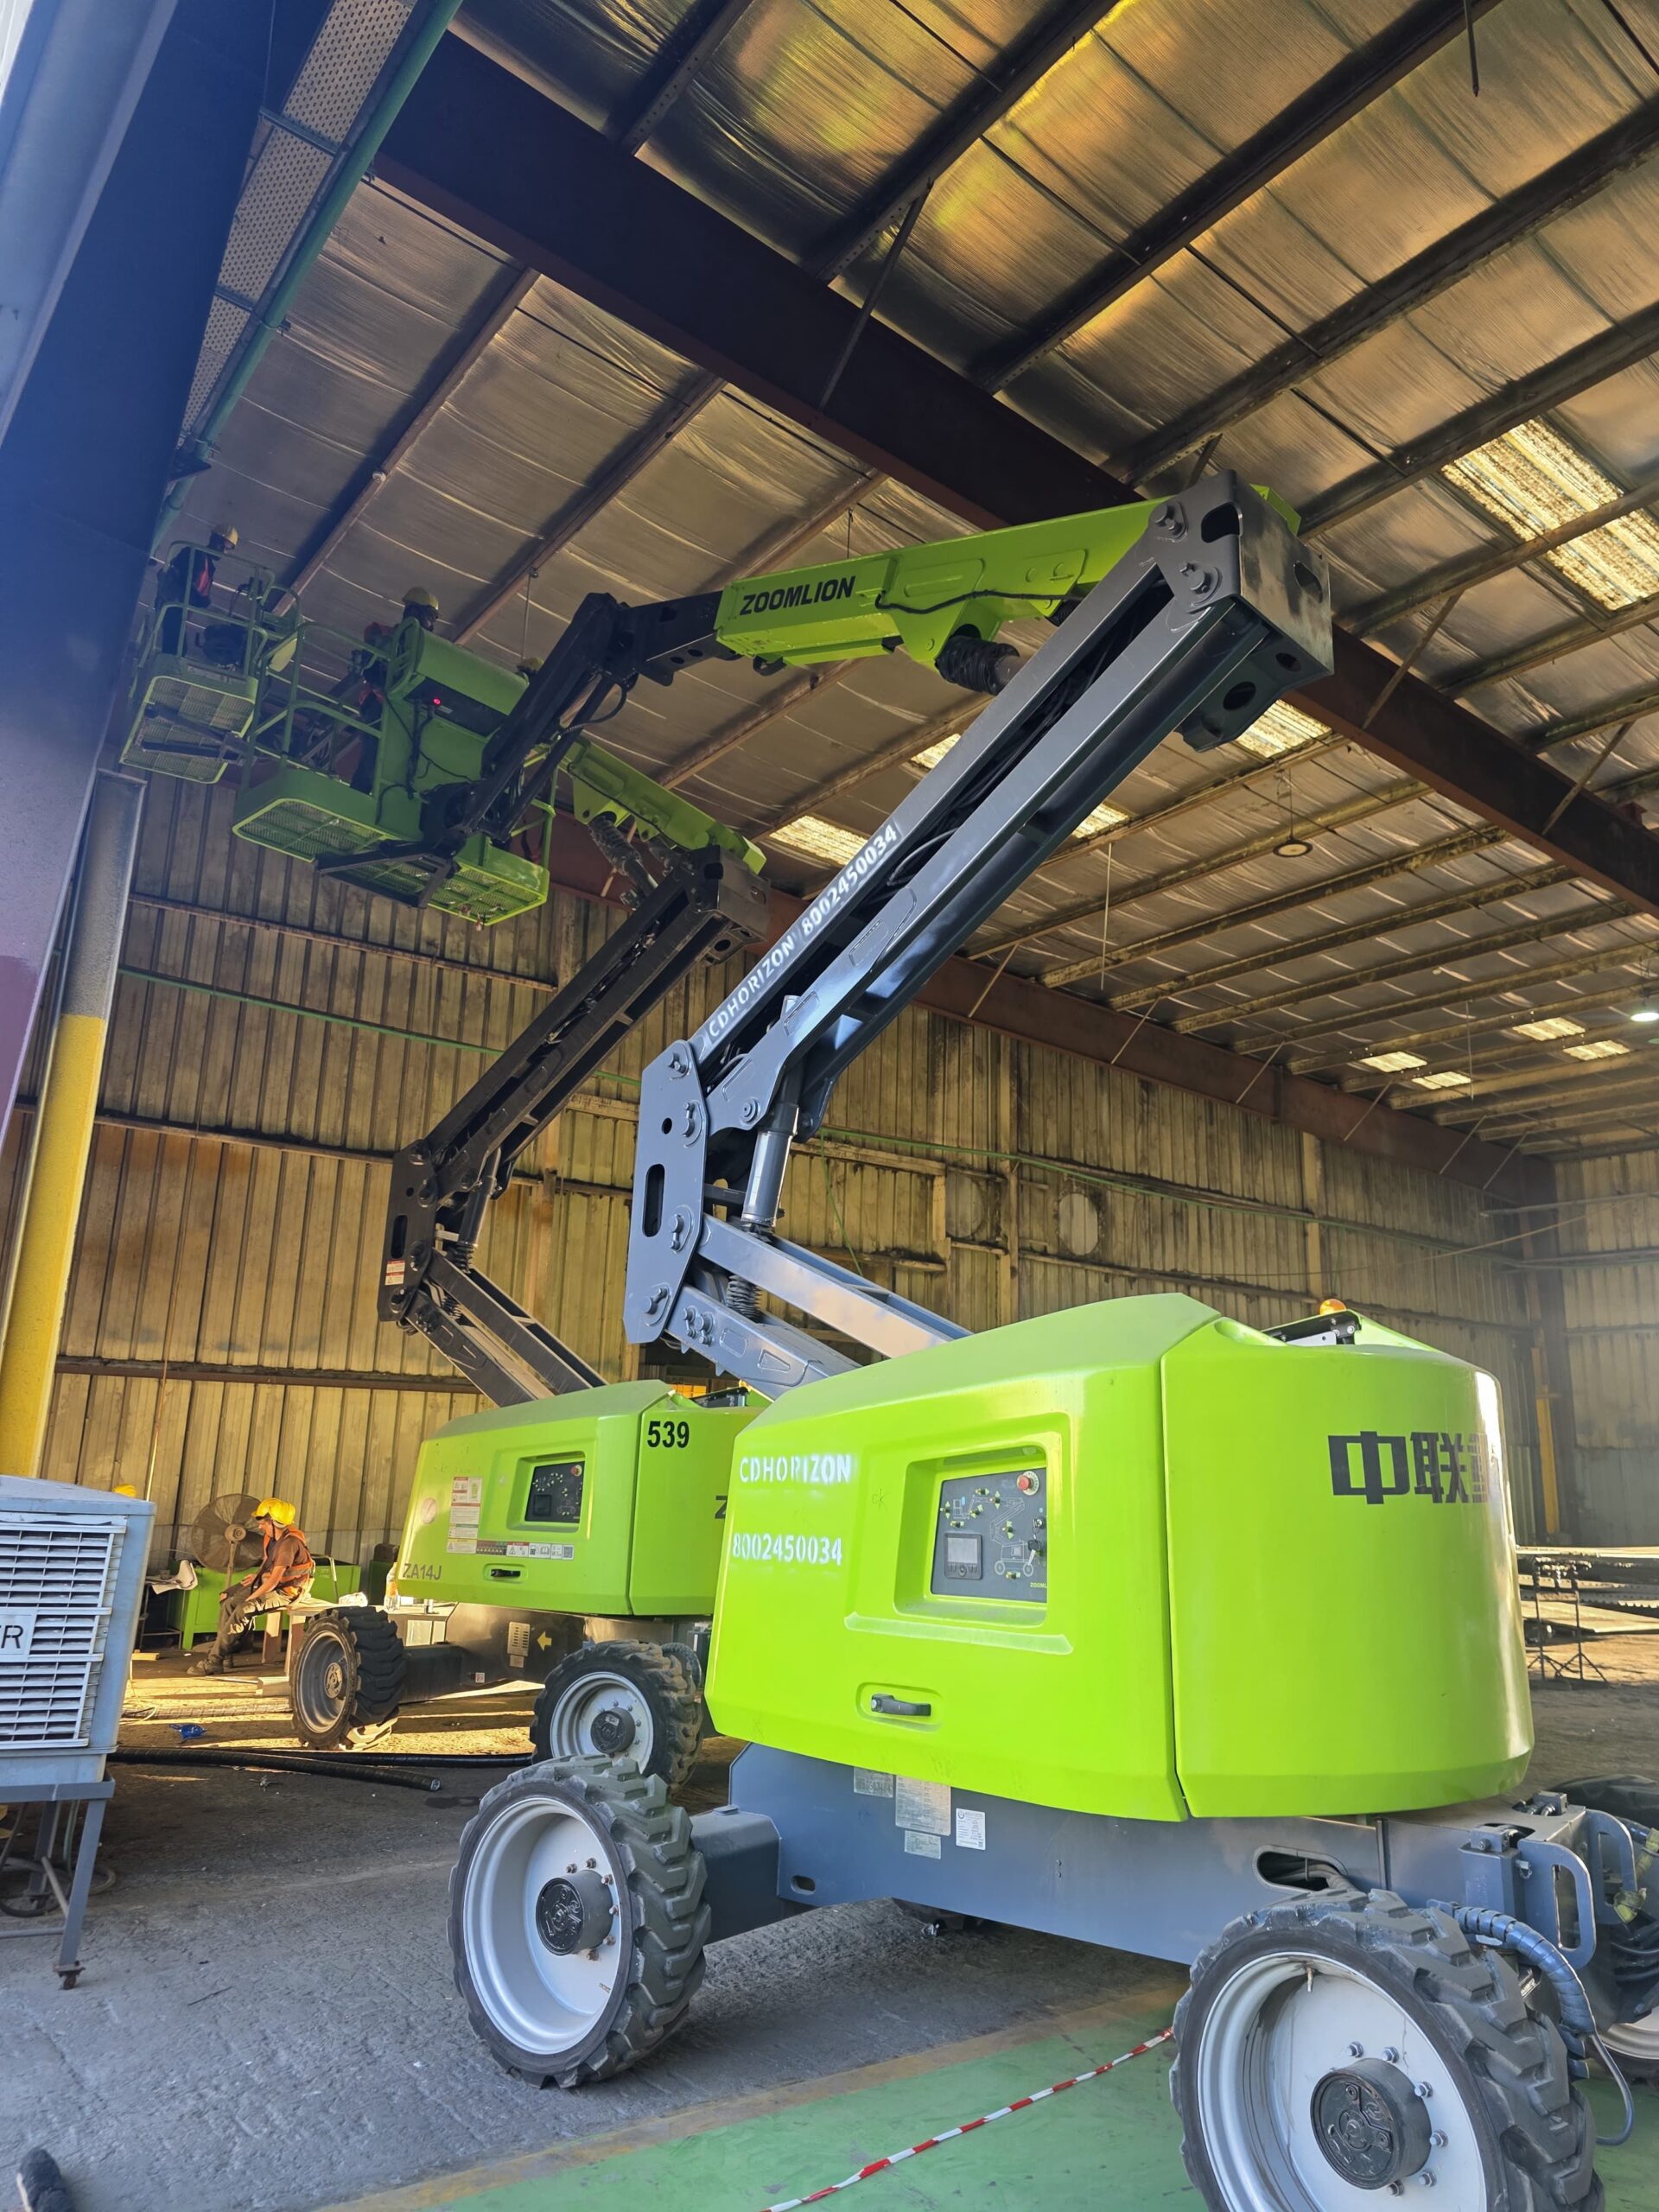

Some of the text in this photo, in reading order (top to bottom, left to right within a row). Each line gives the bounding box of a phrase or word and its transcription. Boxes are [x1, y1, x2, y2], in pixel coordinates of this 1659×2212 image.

[740, 575, 855, 616] ZOOMLION
[709, 823, 898, 1038] CDHORIZON 8002450034
[647, 1421, 690, 1448] 539
[740, 1453, 851, 1485] CDHORIZON
[733, 1533, 842, 1566] 8002450034
[403, 1563, 442, 1580] ZA14J
